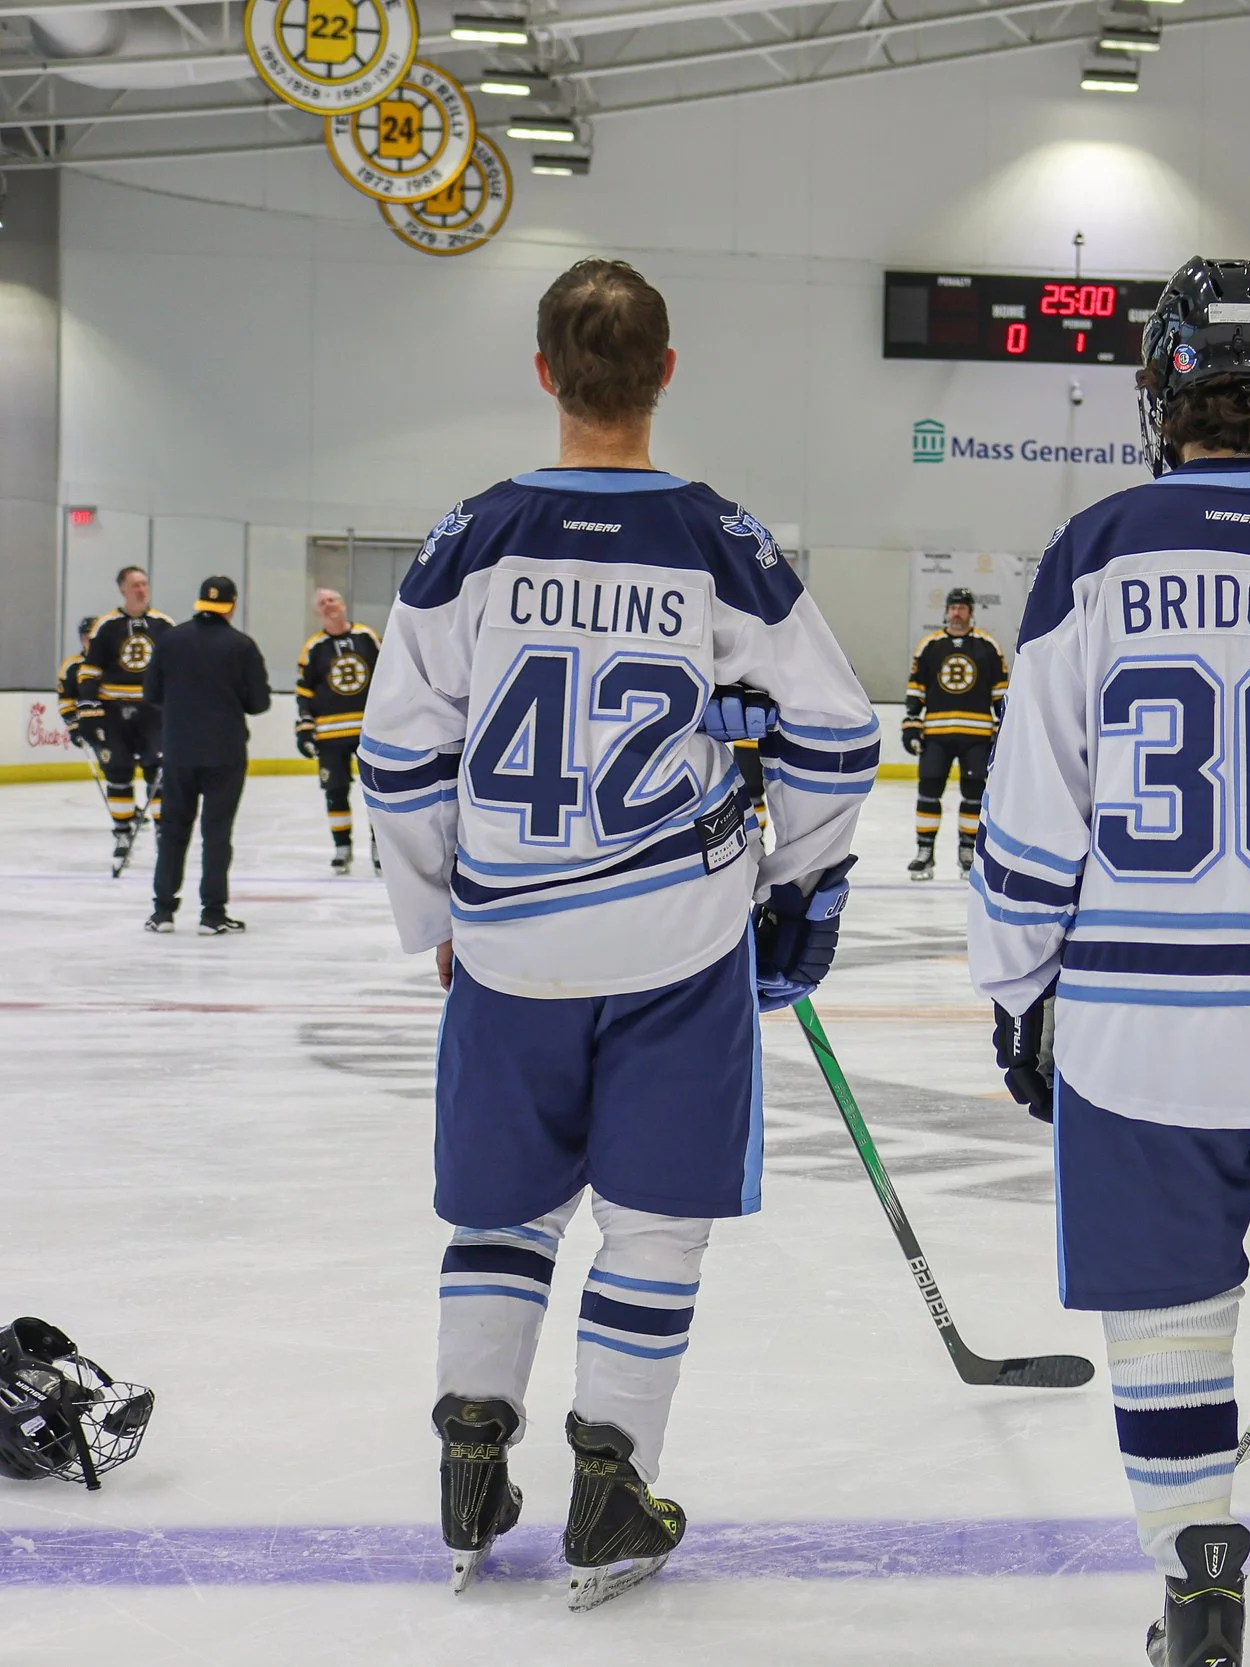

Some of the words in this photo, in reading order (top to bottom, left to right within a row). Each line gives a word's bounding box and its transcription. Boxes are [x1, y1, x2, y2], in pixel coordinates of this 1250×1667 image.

[311, 14, 348, 40] 22
[421, 73, 465, 139] O'REILLY
[383, 115, 414, 144] 24
[356, 166, 394, 193] 1972
[475, 146, 502, 199] URQUE
[1040, 284, 1116, 317] 25:00
[1006, 323, 1028, 353] 0
[1075, 332, 1086, 353] 1
[952, 437, 1013, 460] Mass
[1021, 439, 1114, 464] General
[511, 576, 684, 637] COLLINS
[463, 644, 710, 847] 42
[1014, 1016, 1022, 1056] TRUE
[450, 1446, 500, 1459] GRAF
